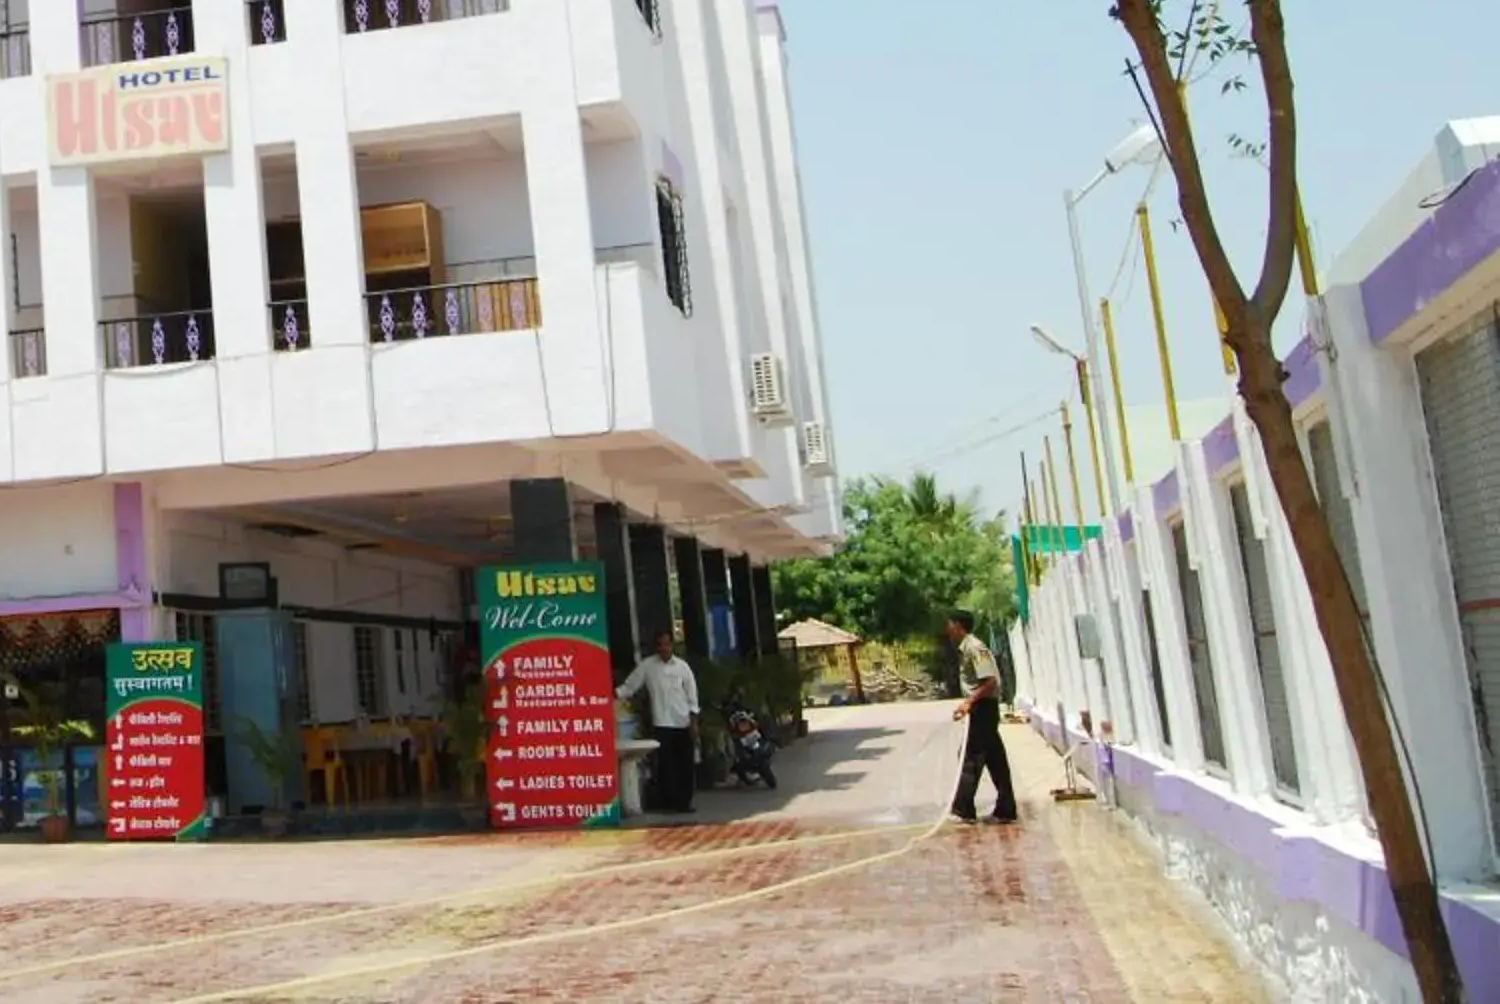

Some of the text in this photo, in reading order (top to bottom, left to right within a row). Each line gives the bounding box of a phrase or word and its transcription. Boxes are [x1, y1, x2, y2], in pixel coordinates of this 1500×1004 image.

[119, 65, 221, 89] HOTEL
[132, 647, 194, 671] उत्सव
[513, 655, 574, 670] FAMILY
[516, 684, 575, 697] GARDEN
[517, 718, 604, 734] FAMILY BAR
[569, 743, 603, 757] HALL
[520, 775, 613, 790] LADIES TOILET
[521, 803, 612, 818] GENTS TOILET
